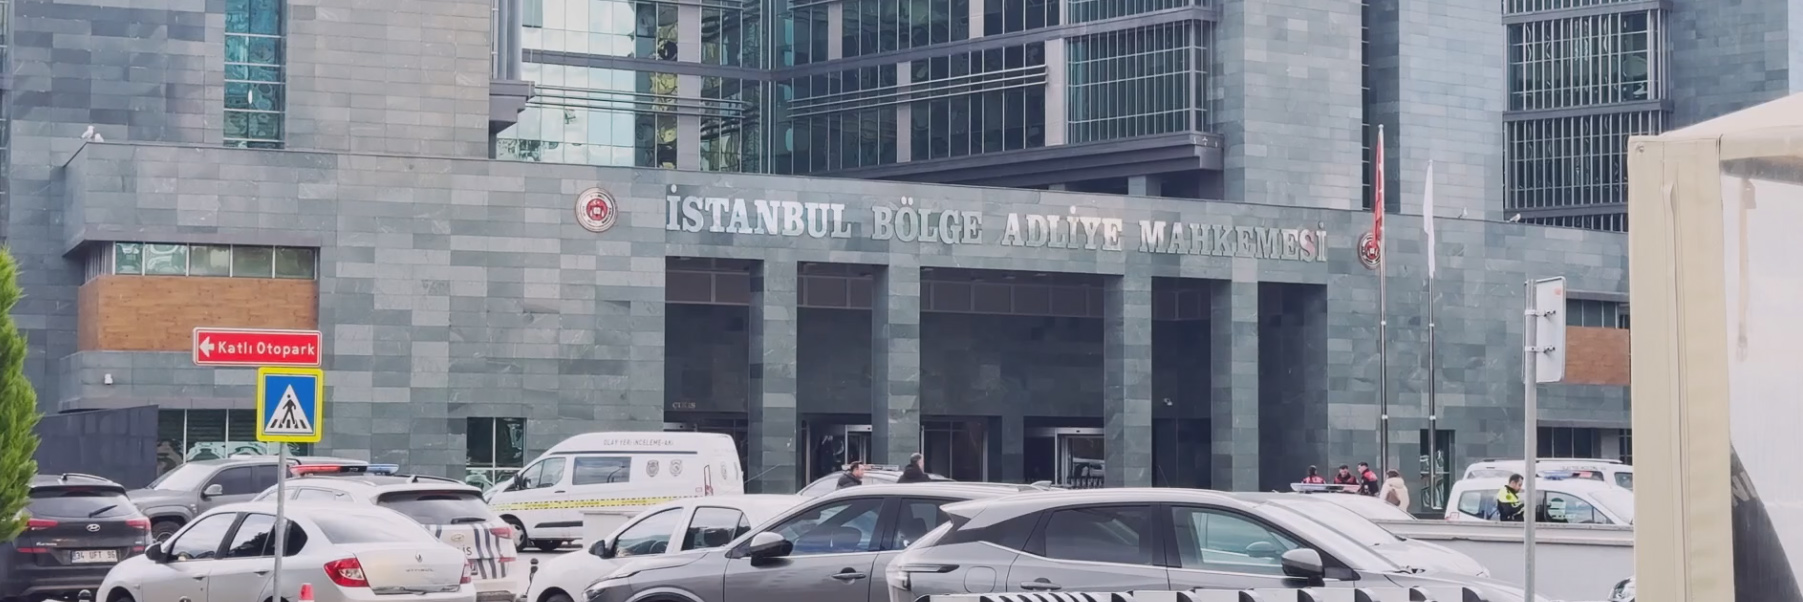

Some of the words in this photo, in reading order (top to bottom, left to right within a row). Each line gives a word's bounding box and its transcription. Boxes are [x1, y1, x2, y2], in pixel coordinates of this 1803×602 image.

[666, 184, 852, 239] İSTANBUL
[871, 196, 983, 245] BÖLGE
[1001, 205, 1123, 251] ADLİYE
[1138, 220, 1328, 263] MAHKEMESİ
[218, 341, 253, 355] Katlı
[256, 341, 315, 359] Otopark
